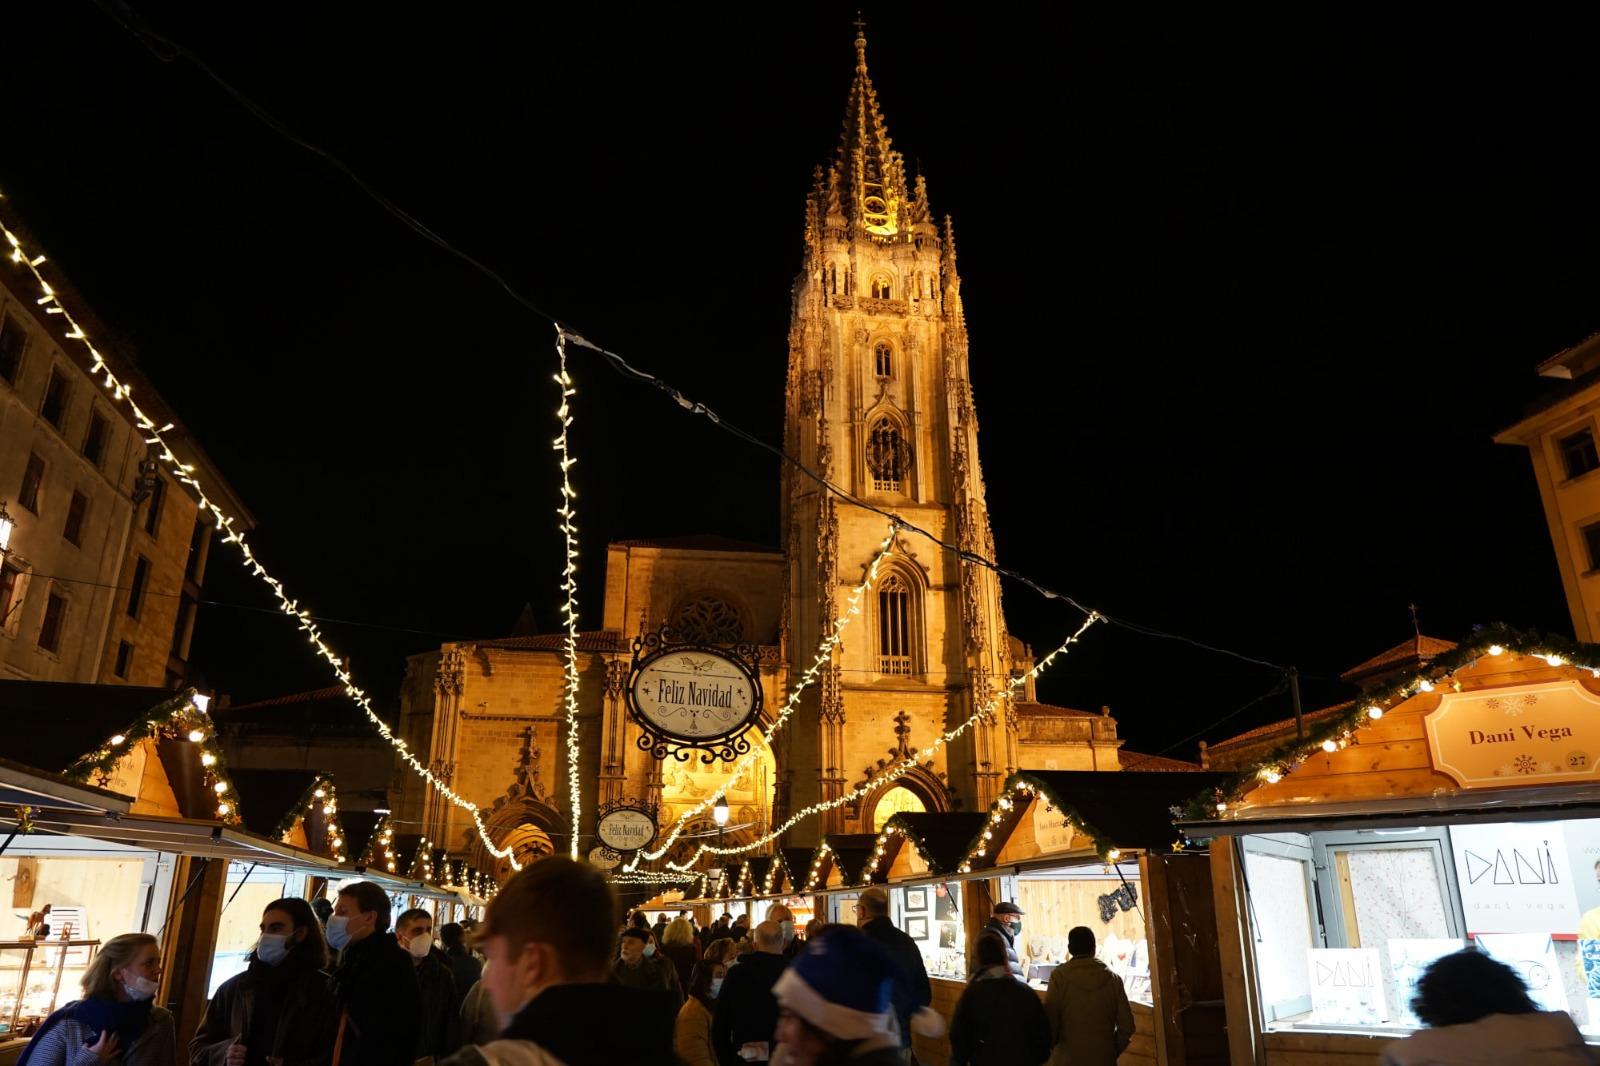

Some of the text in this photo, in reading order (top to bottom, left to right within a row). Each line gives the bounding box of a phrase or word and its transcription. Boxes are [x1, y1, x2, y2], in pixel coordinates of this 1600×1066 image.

[658, 679, 732, 709] Feliz Navidad
[1469, 725, 1573, 745] Dani Vega
[1570, 756, 1586, 766] 27
[608, 823, 645, 837] Feliz Navidad
